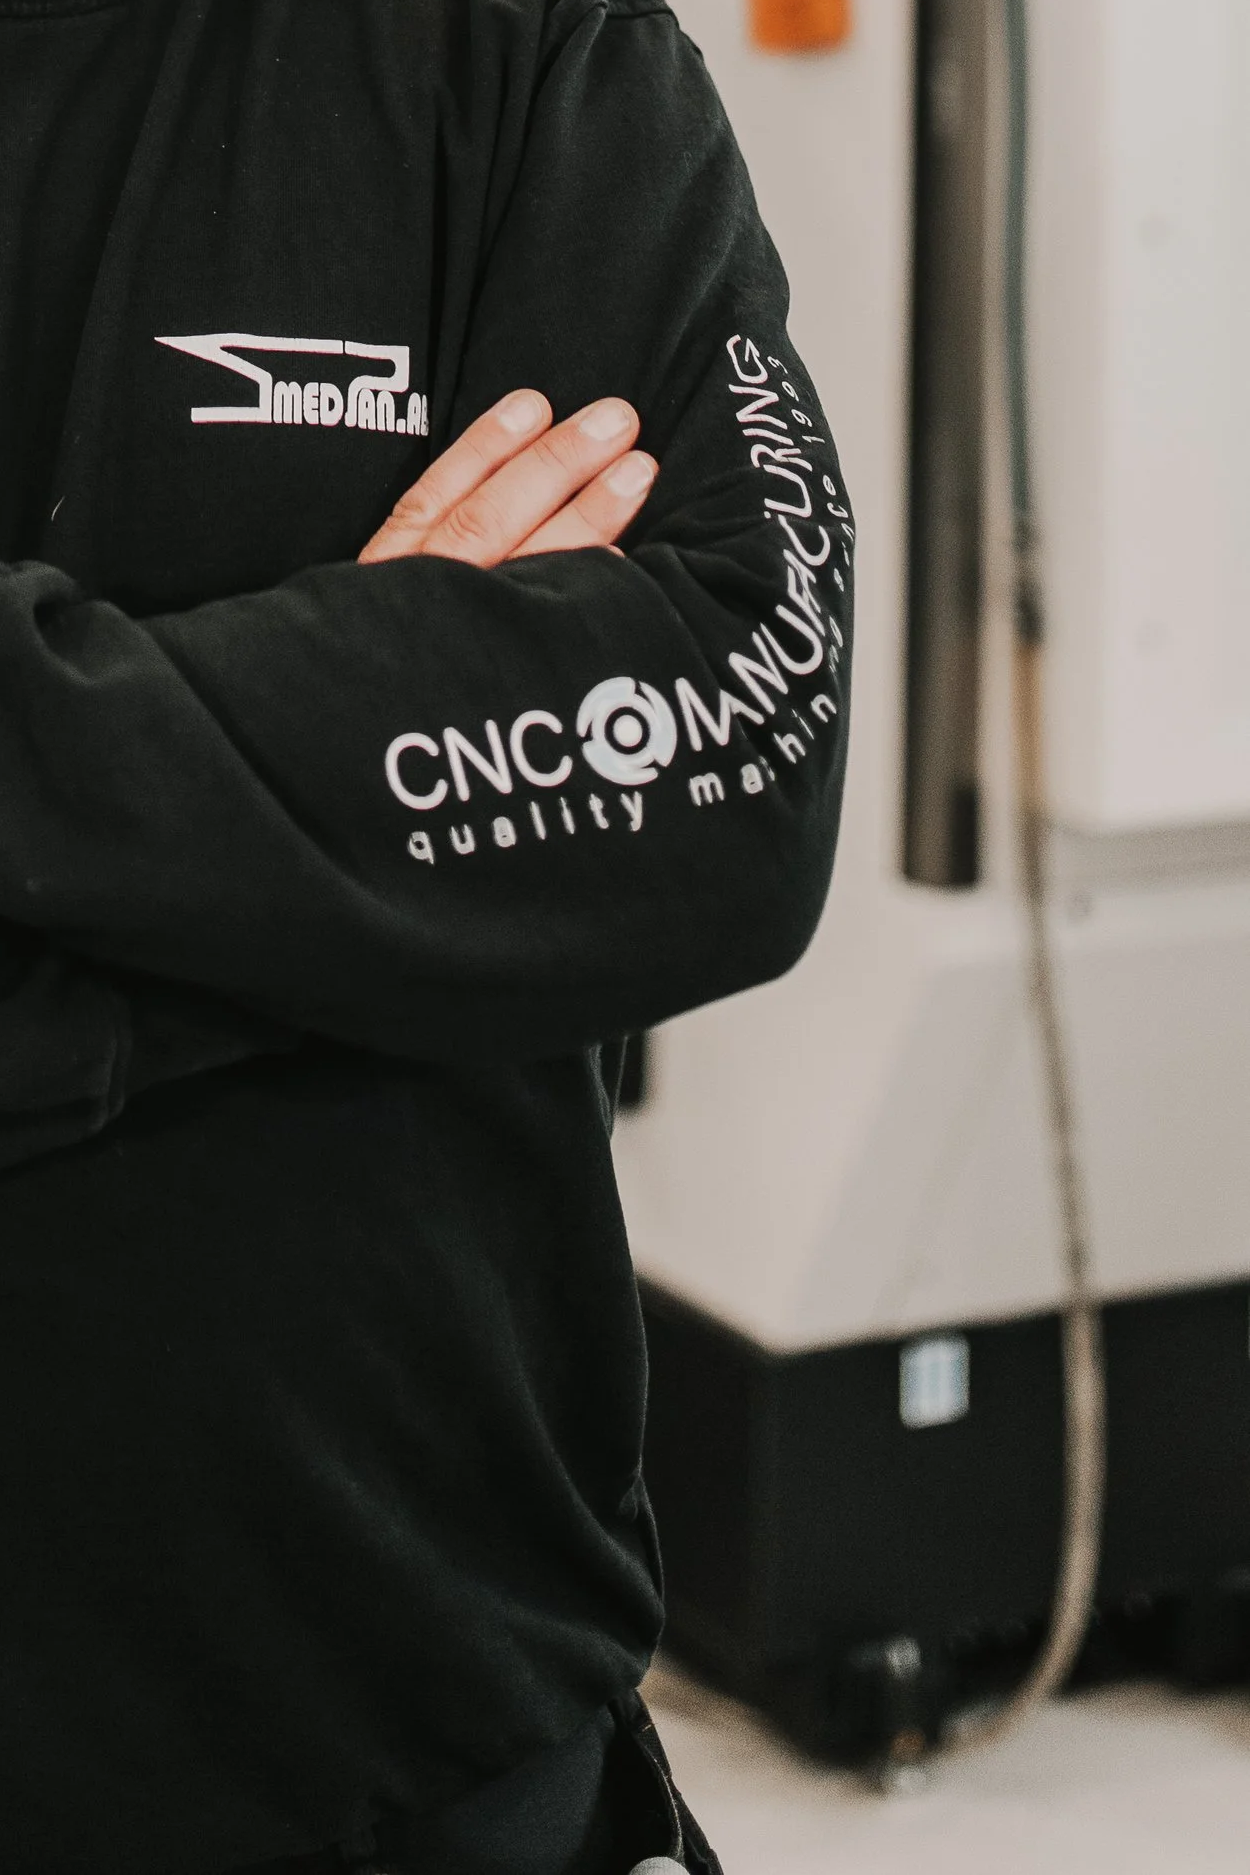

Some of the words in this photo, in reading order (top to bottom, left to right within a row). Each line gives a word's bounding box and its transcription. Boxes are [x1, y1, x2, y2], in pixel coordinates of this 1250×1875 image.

[408, 791, 643, 865] quality
[767, 356, 826, 444] 1993
[675, 334, 831, 751] MANUFACURING
